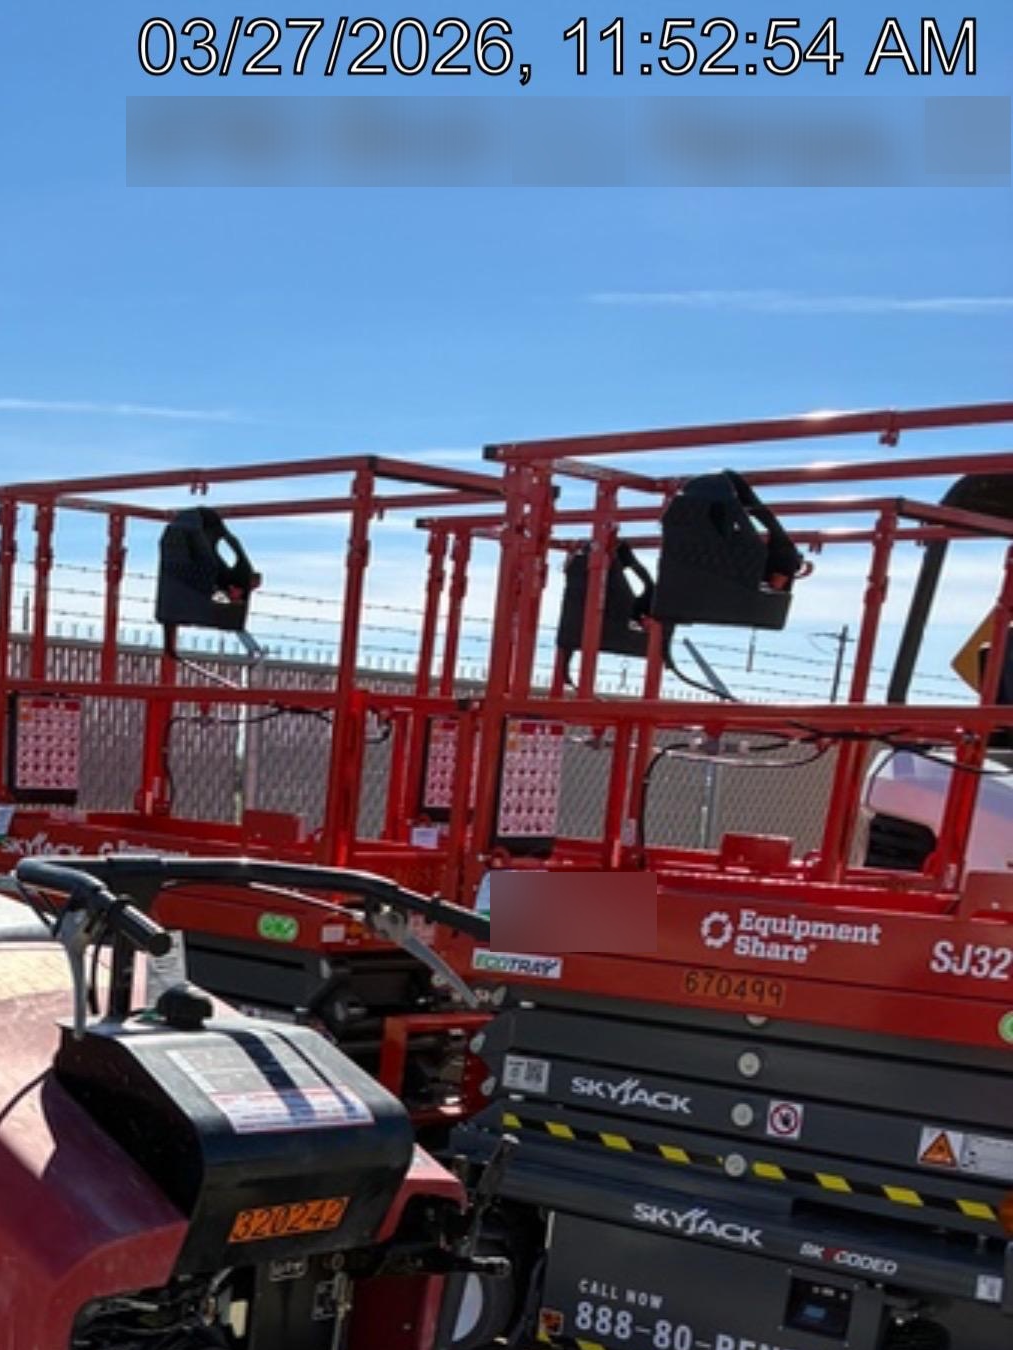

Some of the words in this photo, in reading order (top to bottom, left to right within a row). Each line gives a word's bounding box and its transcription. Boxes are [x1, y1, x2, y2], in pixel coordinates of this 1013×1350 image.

[738, 908, 882, 946] Equipment
[734, 935, 808, 963] Share
[685, 970, 784, 1006] 670499
[571, 1076, 692, 1114] SKYJACK
[231, 1199, 343, 1240] 320242
[633, 1202, 763, 1248] SKYJACK
[578, 1279, 618, 1300] CALL
[625, 1289, 663, 1309] NOW
